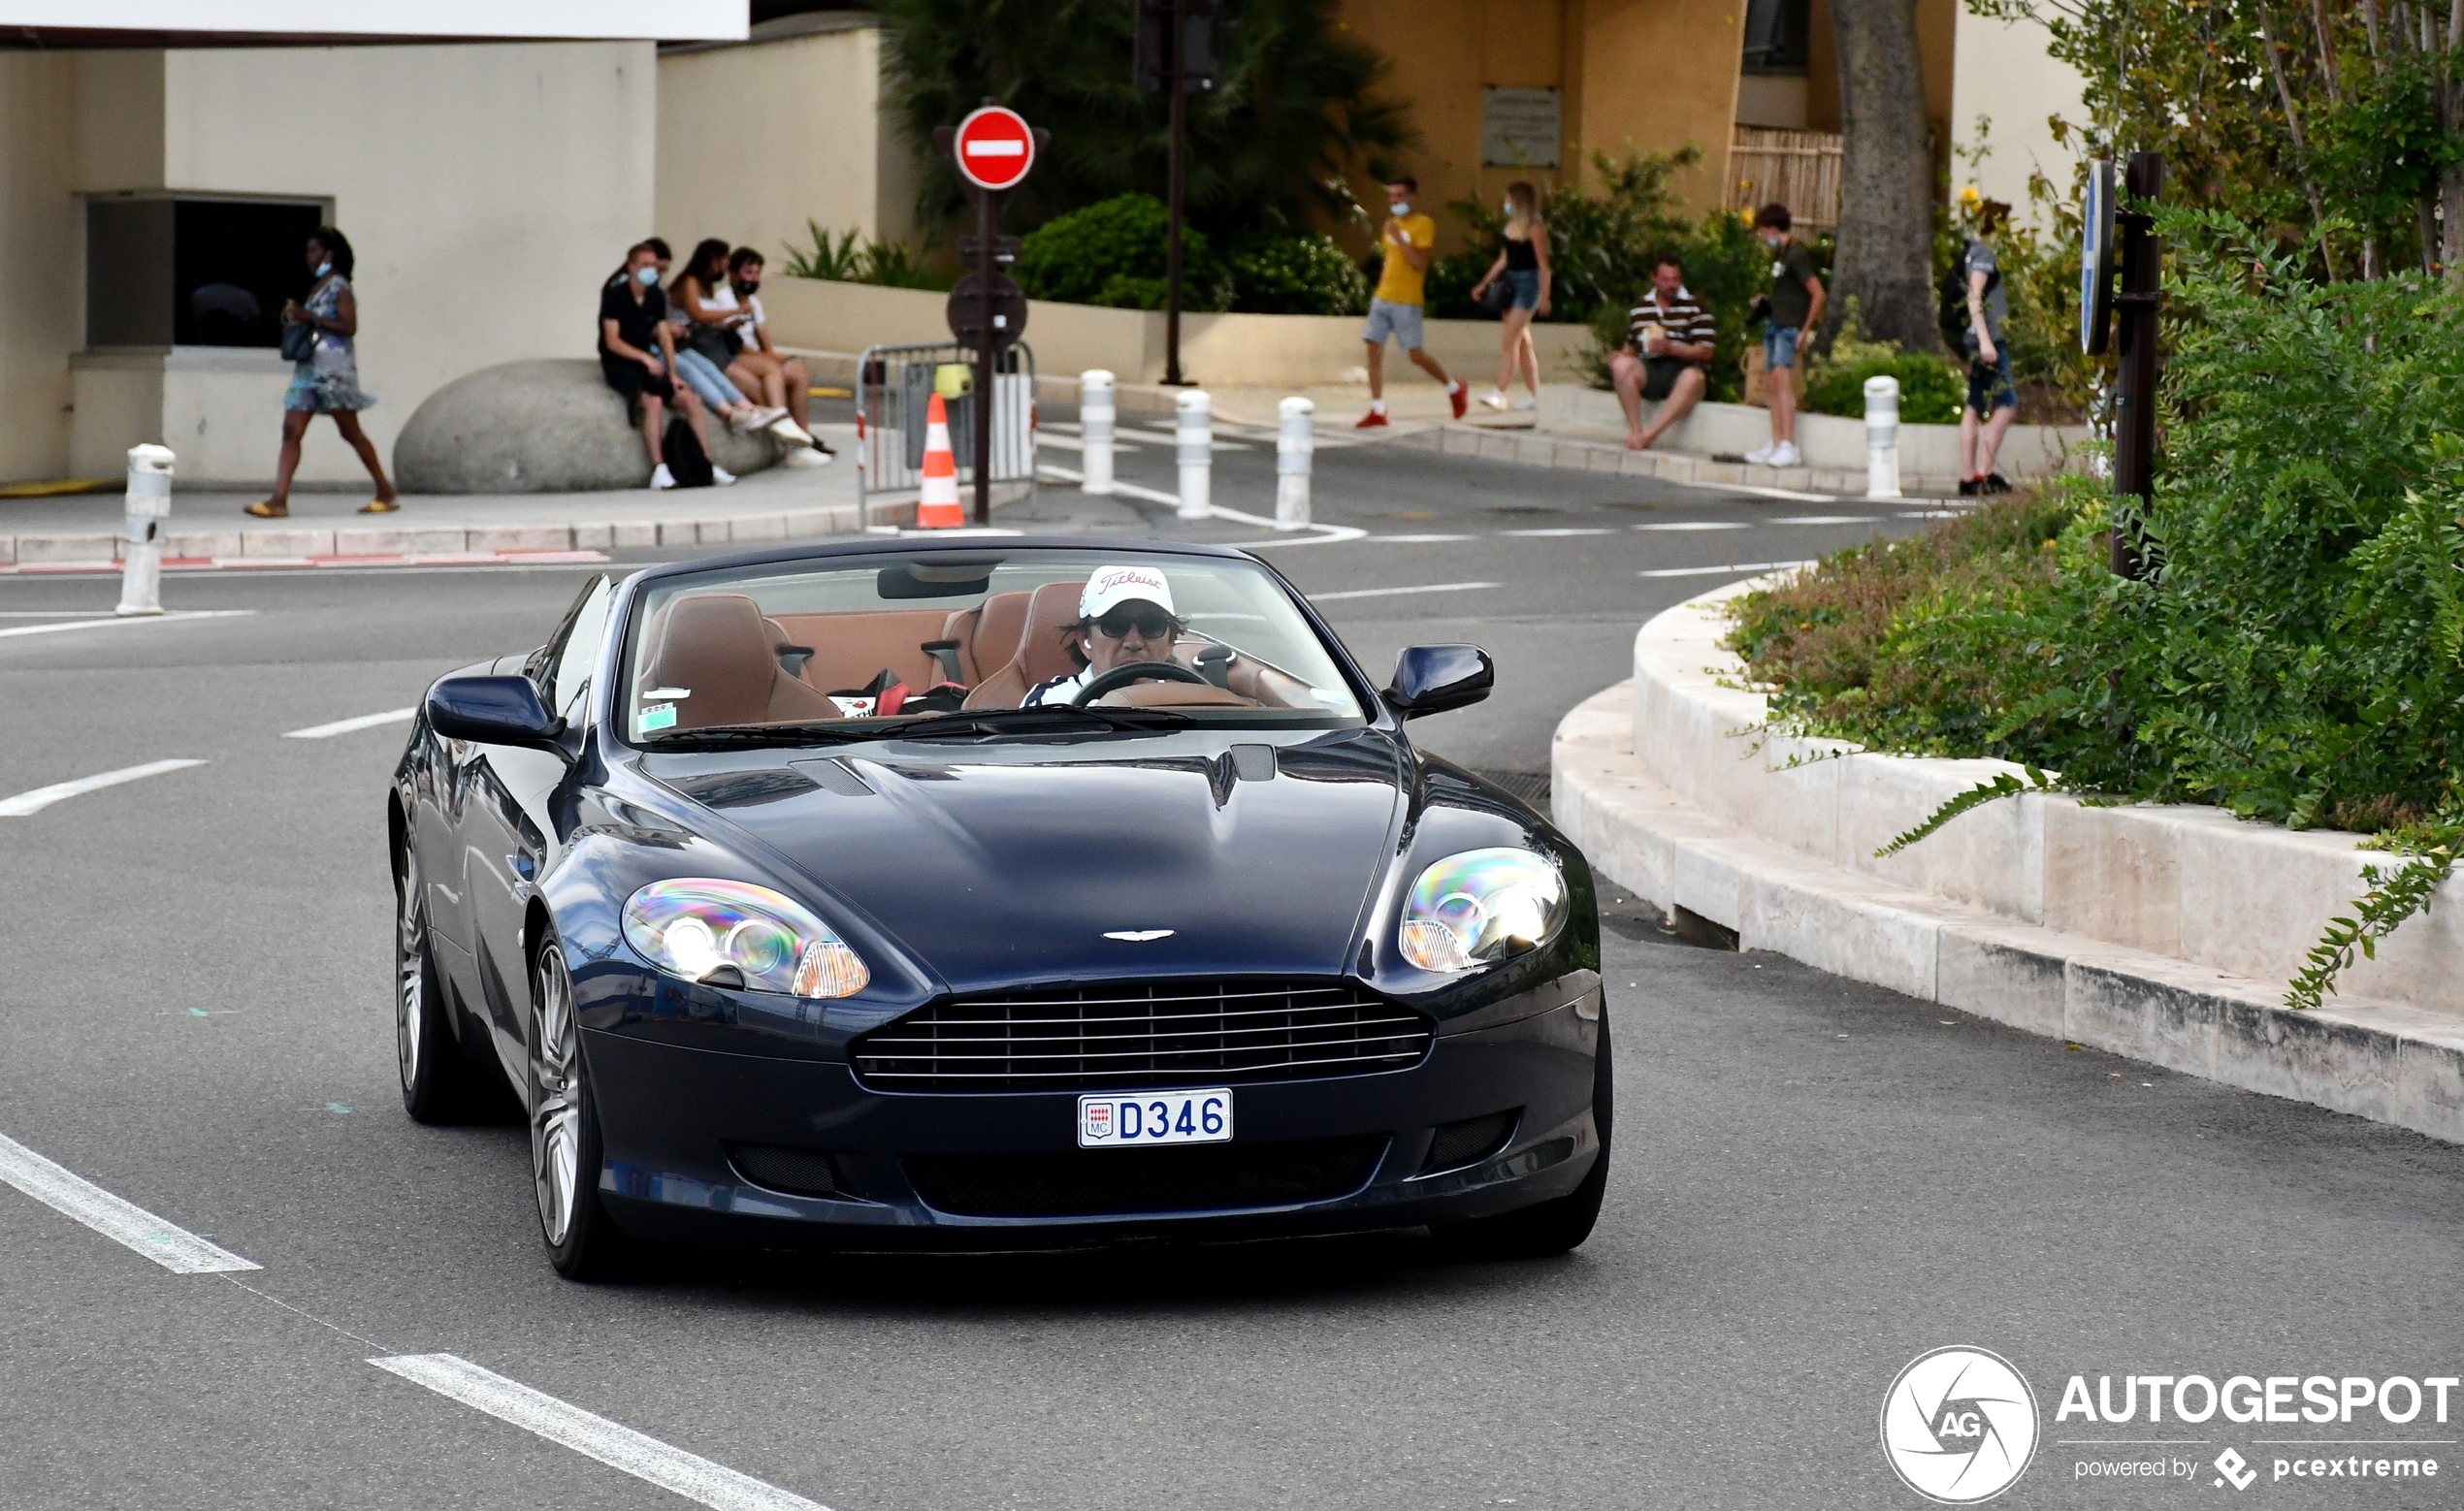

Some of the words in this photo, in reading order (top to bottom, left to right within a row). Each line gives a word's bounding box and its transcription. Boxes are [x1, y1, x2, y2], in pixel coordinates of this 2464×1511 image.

[1097, 570, 1162, 595] Titleist
[1090, 1122, 1108, 1134] MC
[1120, 1098, 1223, 1139] D346
